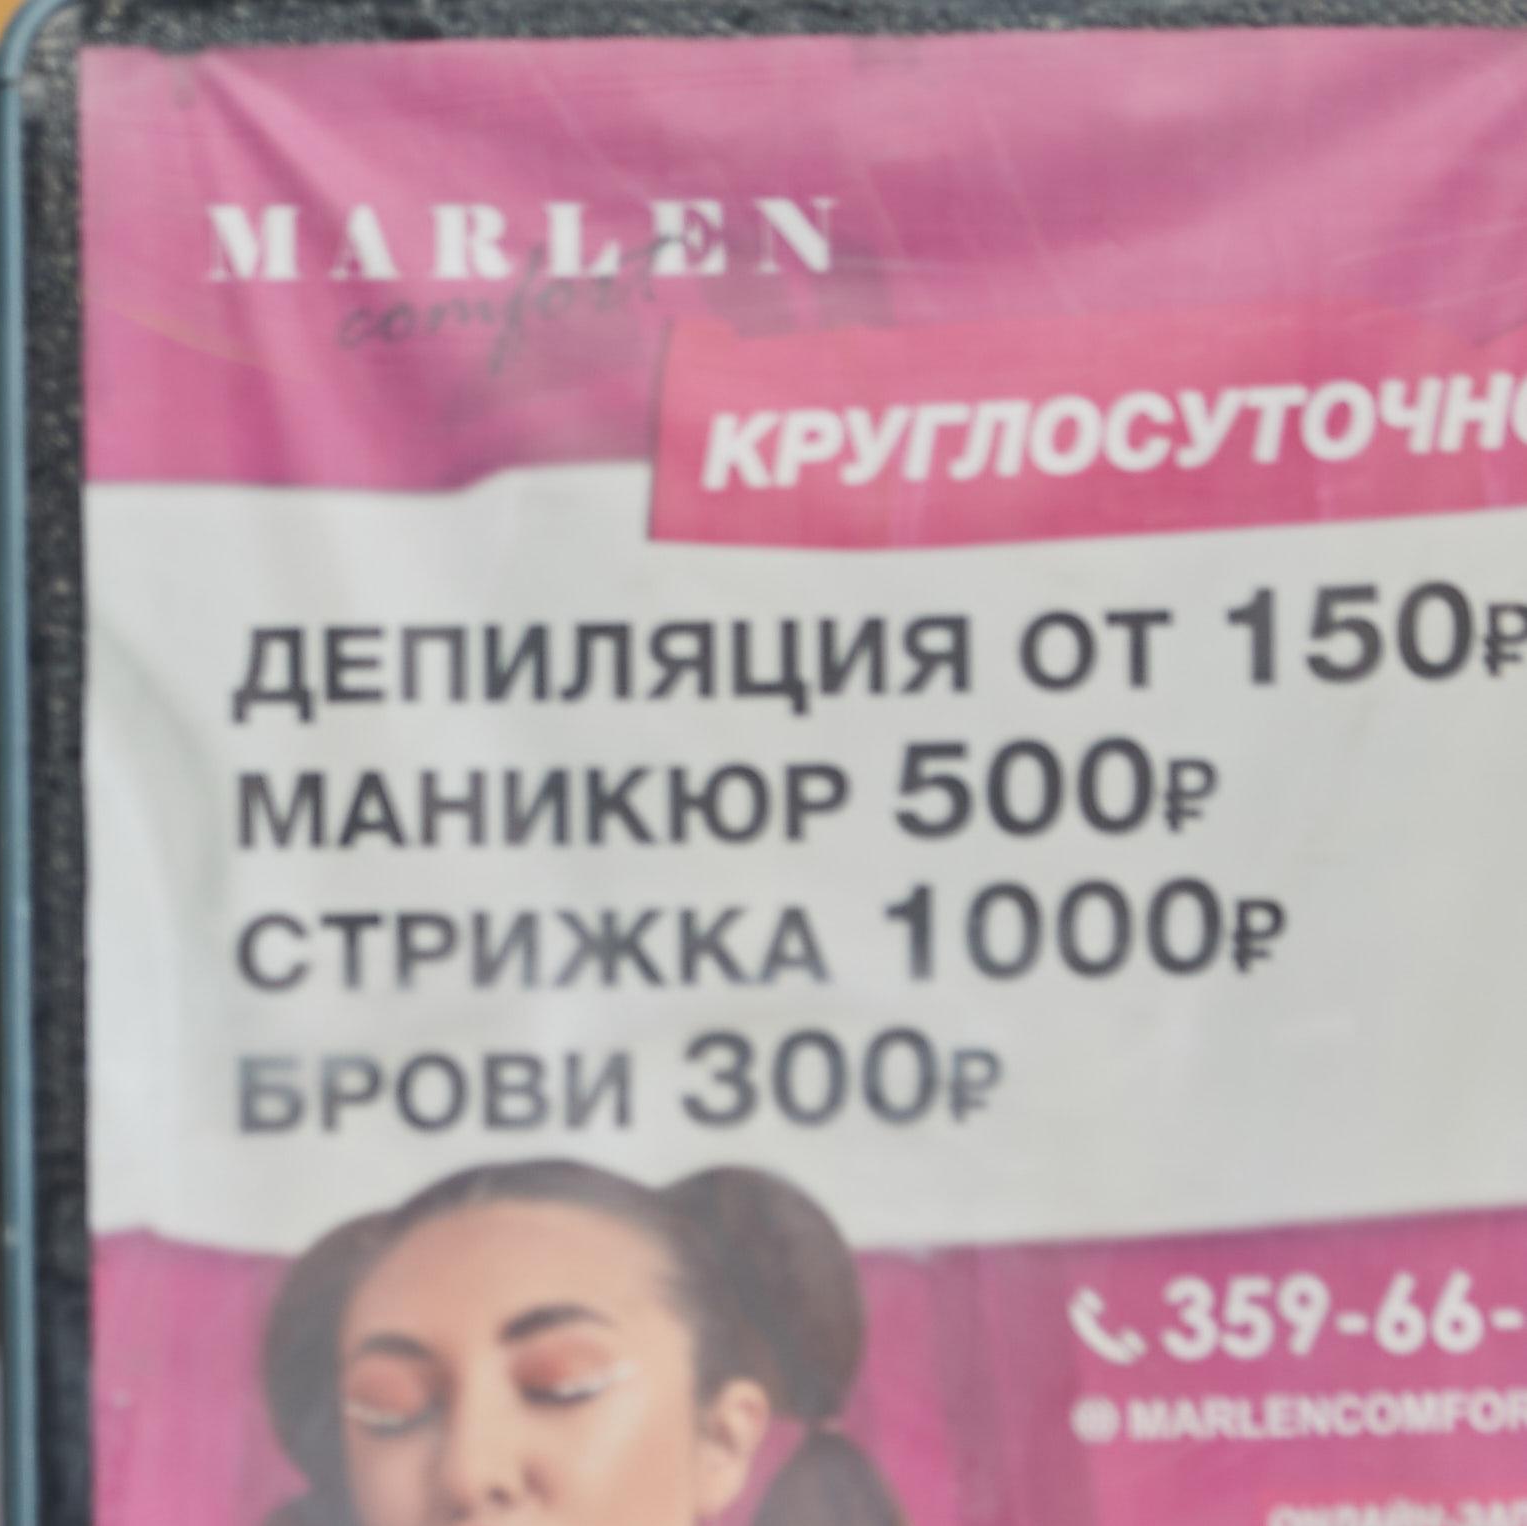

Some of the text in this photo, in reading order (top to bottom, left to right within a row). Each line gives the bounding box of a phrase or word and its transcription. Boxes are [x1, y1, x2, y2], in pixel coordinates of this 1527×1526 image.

[203, 195, 839, 283] MARLEN
[700, 369, 1527, 493] КРУГЛОСУТОЧН
[230, 614, 974, 723] ДЕПИЛЯЦИЯ
[1019, 607, 1175, 693] ОТ
[234, 757, 851, 852] МАНИКЮР
[234, 903, 832, 994] СТРИЖКА
[235, 1046, 636, 1136] БРОВИ
